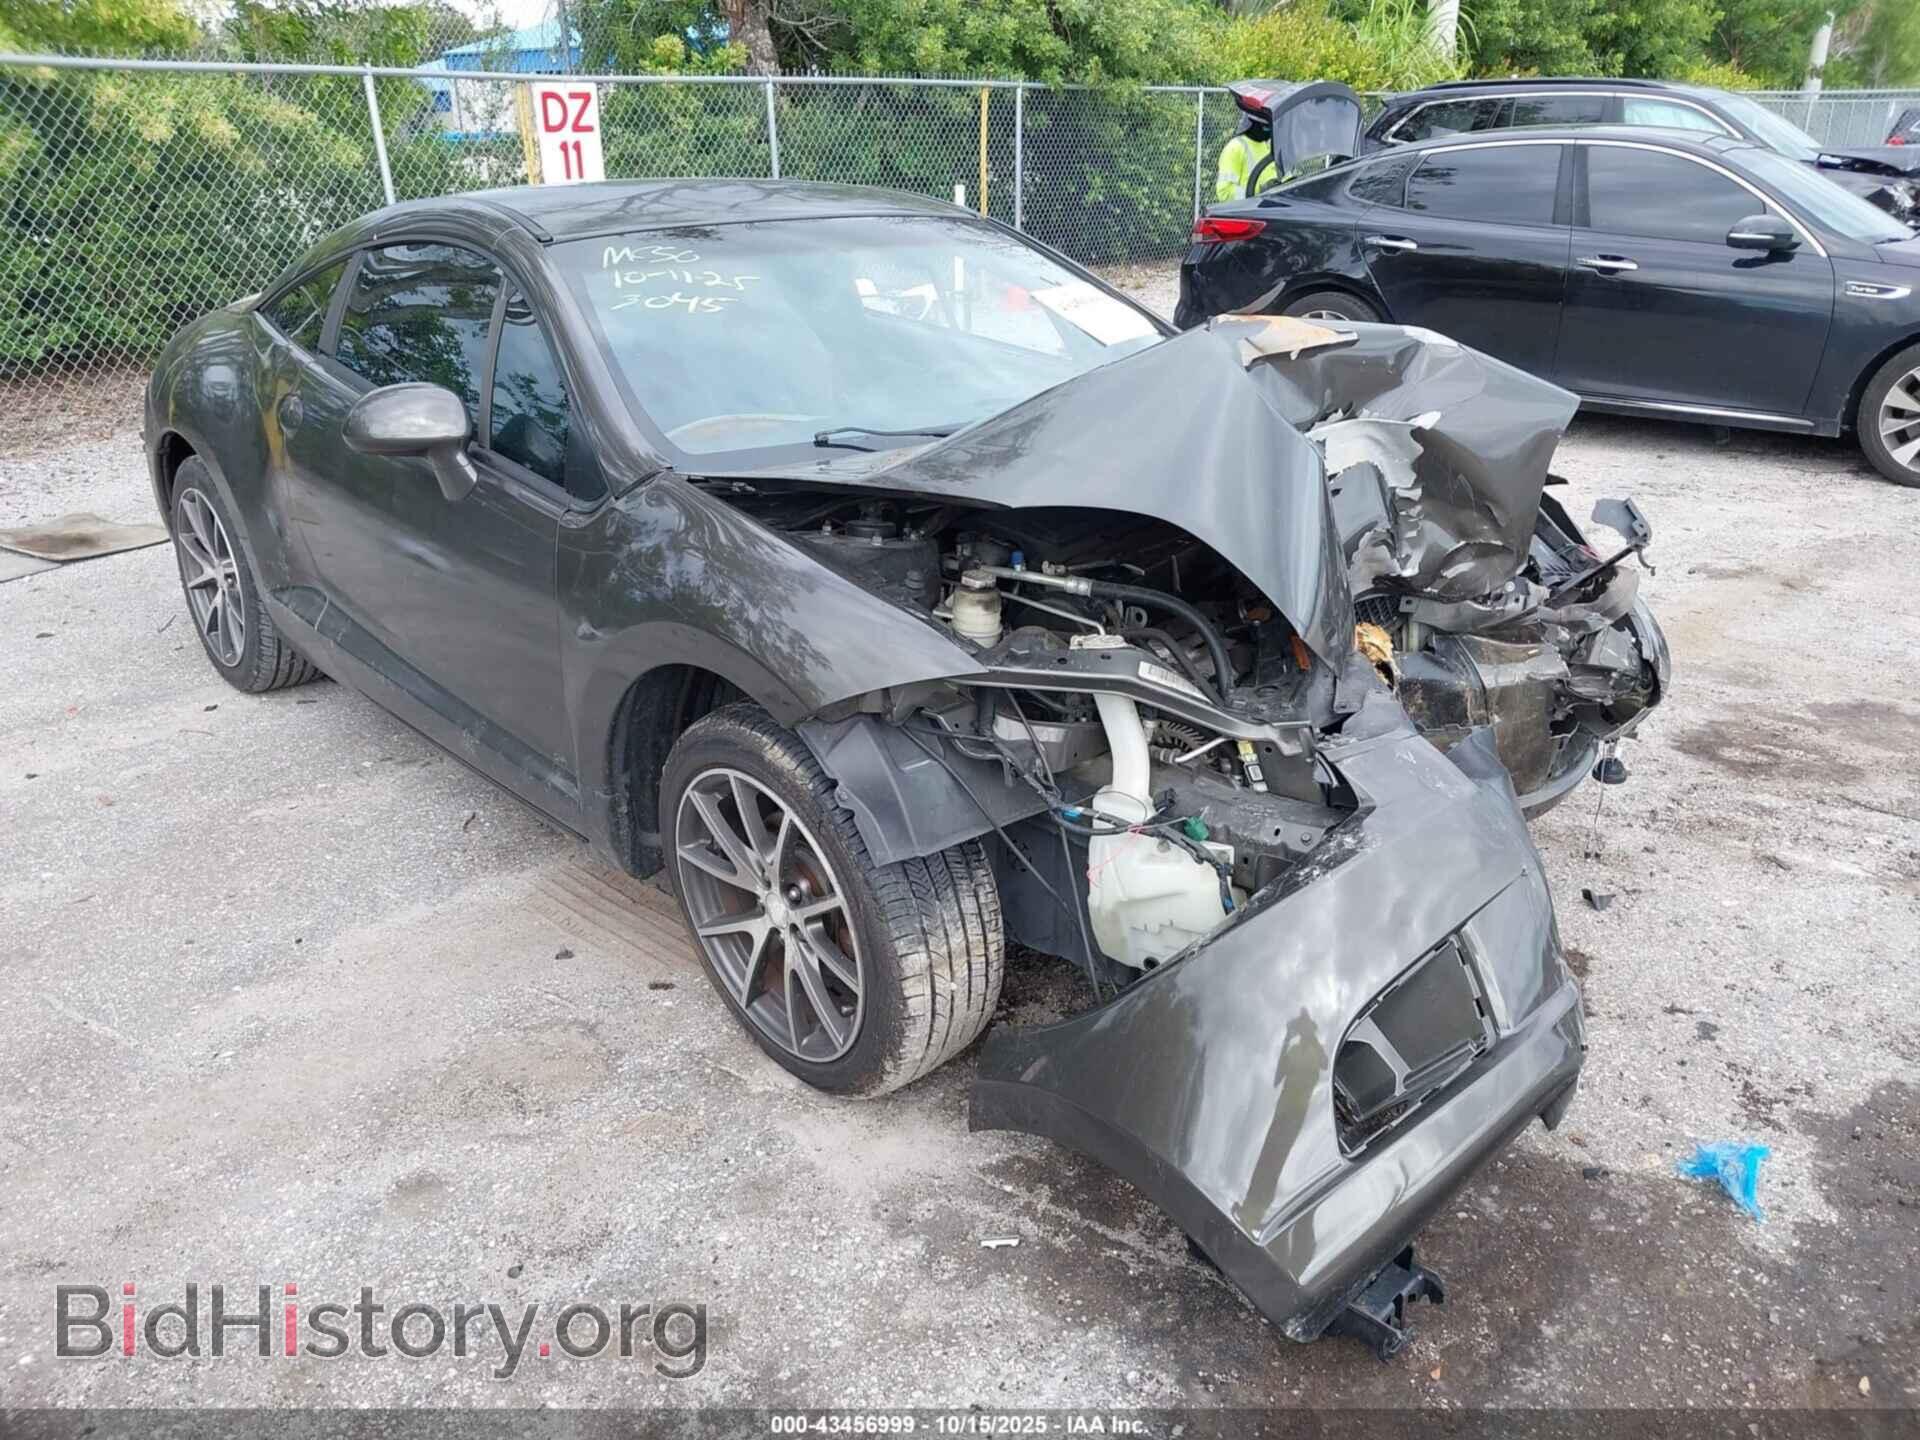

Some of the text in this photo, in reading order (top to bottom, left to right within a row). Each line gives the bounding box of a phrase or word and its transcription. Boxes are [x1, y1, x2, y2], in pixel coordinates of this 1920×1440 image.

[541, 92, 594, 133] DZ
[559, 140, 583, 180] 11
[615, 269, 760, 291] 10-11-25
